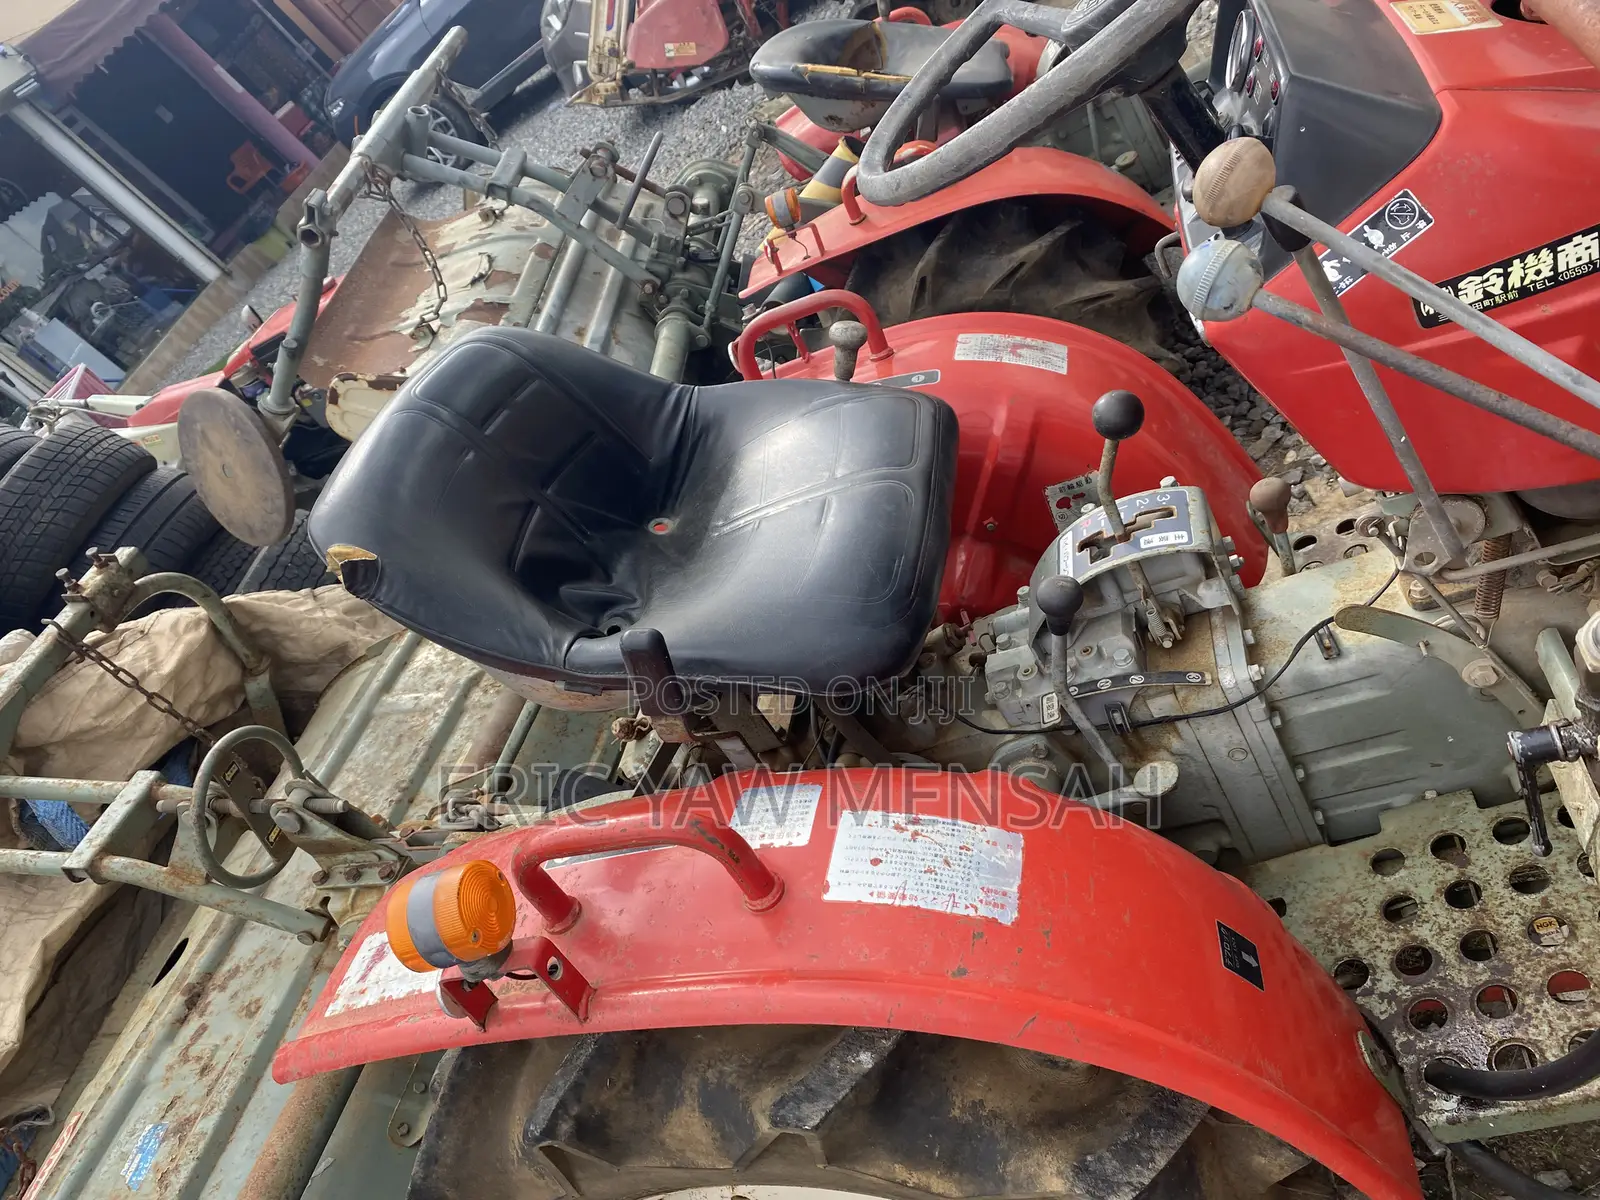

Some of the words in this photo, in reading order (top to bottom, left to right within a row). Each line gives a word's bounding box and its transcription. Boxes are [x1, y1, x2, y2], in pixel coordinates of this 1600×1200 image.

[1438, 290, 1519, 323] 三田町駅前
[1527, 281, 1555, 293] TEL
[1136, 499, 1149, 507] 2
[1157, 494, 1170, 502] 3
[1536, 920, 1556, 930] NGK
